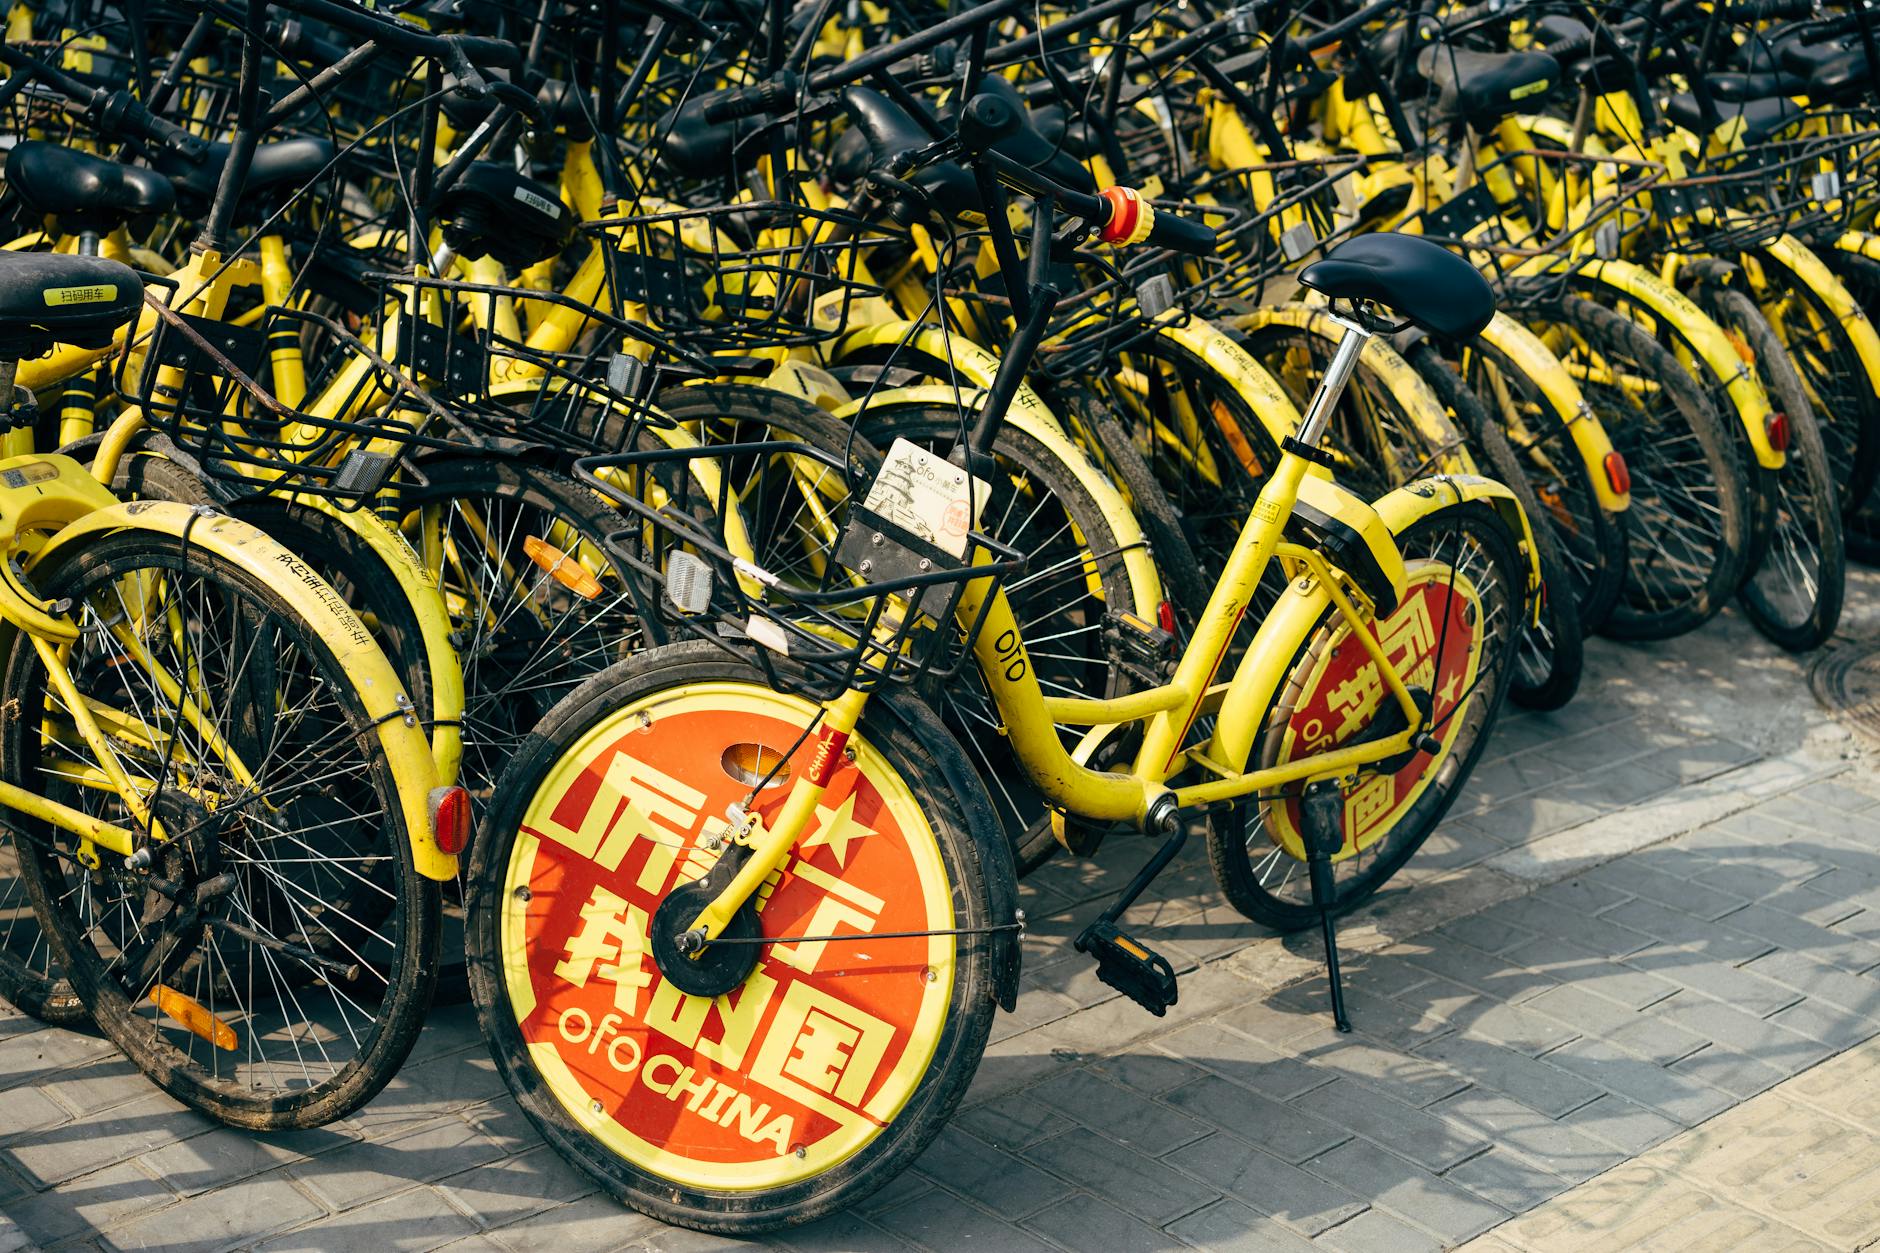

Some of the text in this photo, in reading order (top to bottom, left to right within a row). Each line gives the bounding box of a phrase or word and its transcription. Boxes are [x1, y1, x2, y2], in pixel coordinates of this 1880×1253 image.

[61, 288, 104, 303] 扫码用车
[918, 466, 935, 481] ofo
[995, 629, 1026, 682] ofo
[808, 731, 834, 782] CHINA
